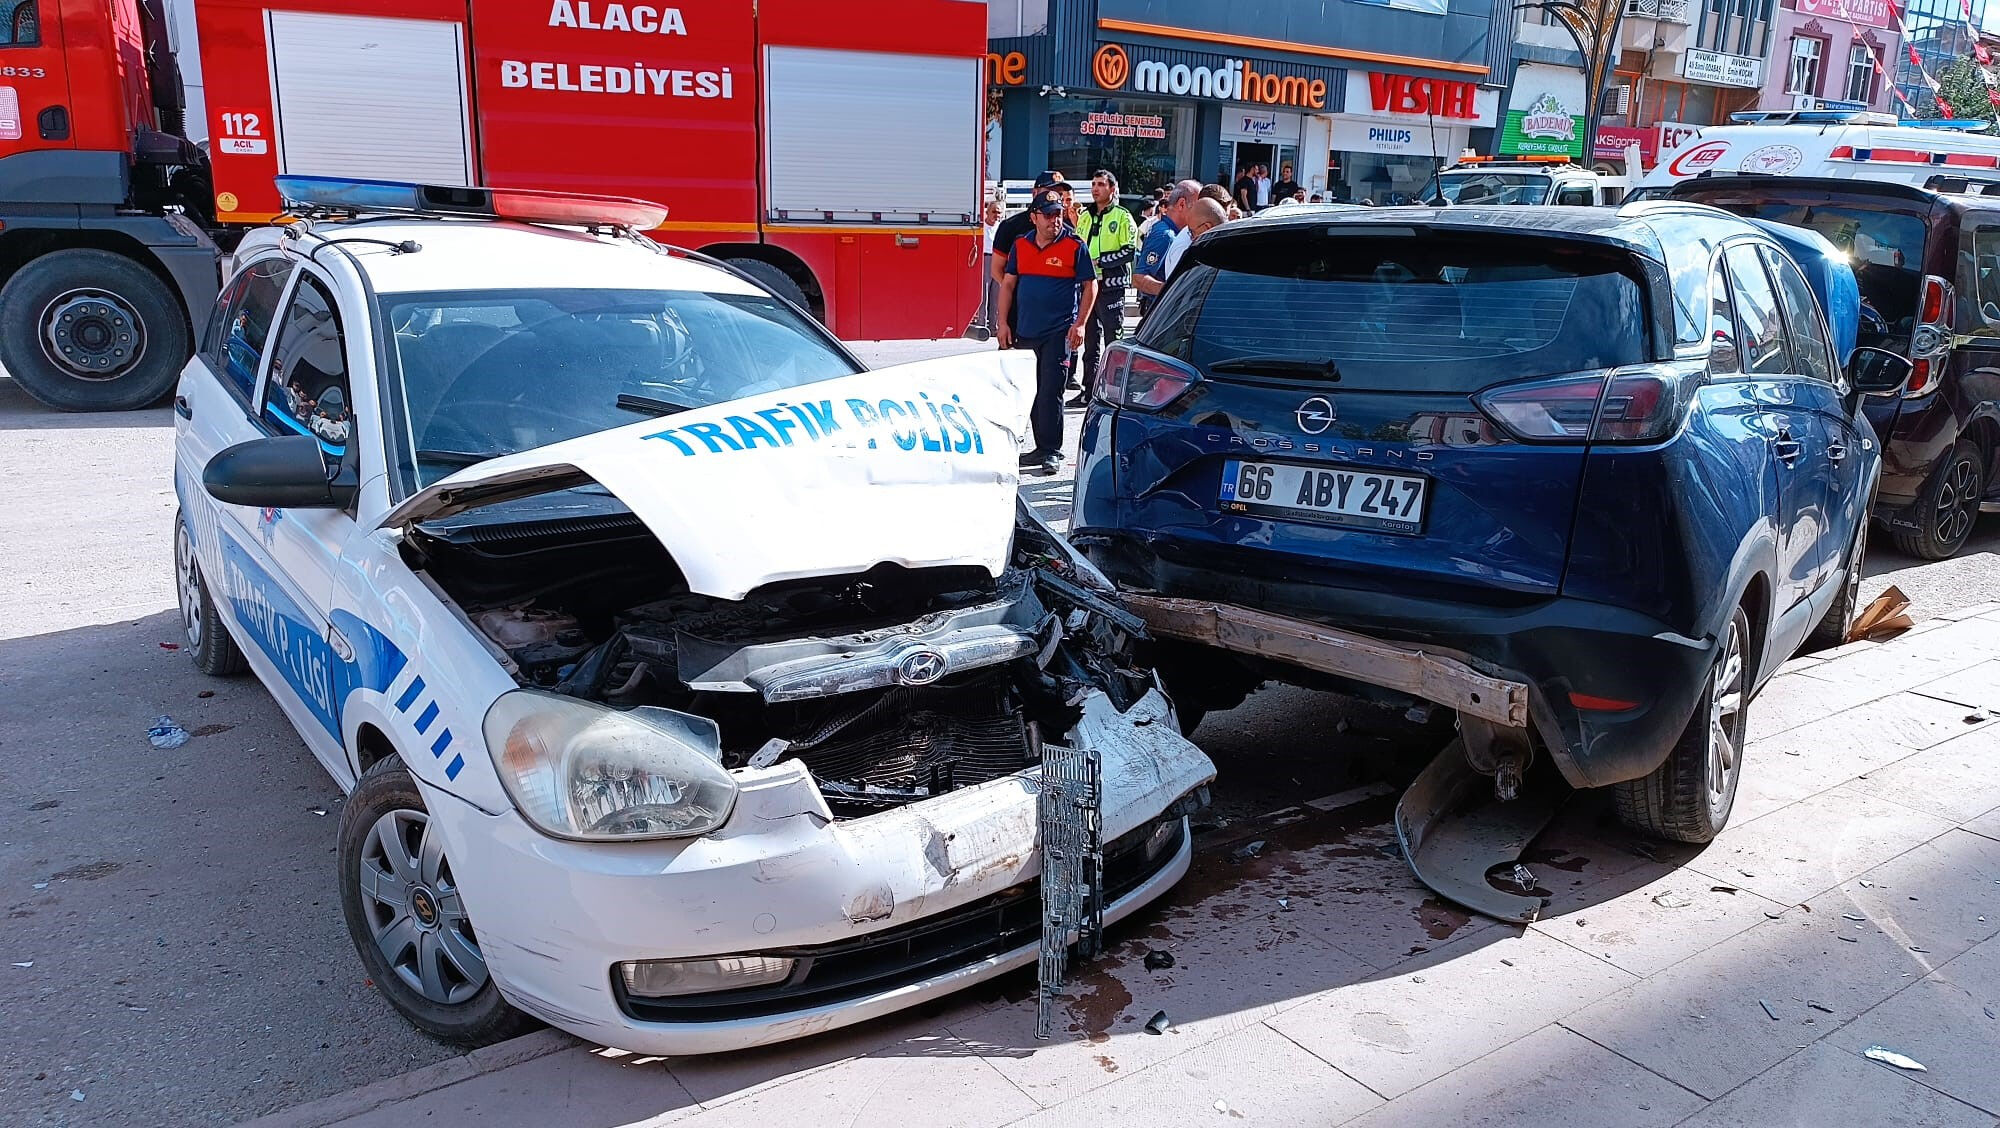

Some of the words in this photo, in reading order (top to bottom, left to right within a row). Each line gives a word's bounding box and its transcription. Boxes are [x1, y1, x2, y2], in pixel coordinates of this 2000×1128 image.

[548, 0, 688, 36] ALACA
[0, 66, 46, 78] 833
[501, 60, 733, 99] BELEDİYESİ
[1134, 59, 1326, 109] mondihome
[1367, 72, 1481, 119] VESTEL
[222, 112, 261, 136] 112
[1080, 121, 1096, 135] 36
[1096, 125, 1108, 135] AY
[1108, 125, 1136, 137] TAKSİT
[1088, 111, 1123, 125] KEFİLSİZ
[1124, 115, 1162, 127] SENETSİZ
[1369, 127, 1411, 143] PHILIPS
[1696, 151, 1717, 160] 112
[639, 400, 842, 457] TRAFİK
[844, 391, 985, 455] POLİSİ
[1207, 434, 1434, 462] CROSSLAND
[1223, 483, 1235, 493] TR
[1238, 465, 1274, 501] 66
[1296, 470, 1354, 510] ABY
[1360, 477, 1422, 518] 247
[1230, 502, 1248, 512] OPEL
[230, 559, 280, 657] TRAFİK
[279, 615, 333, 720] PLİSİ
